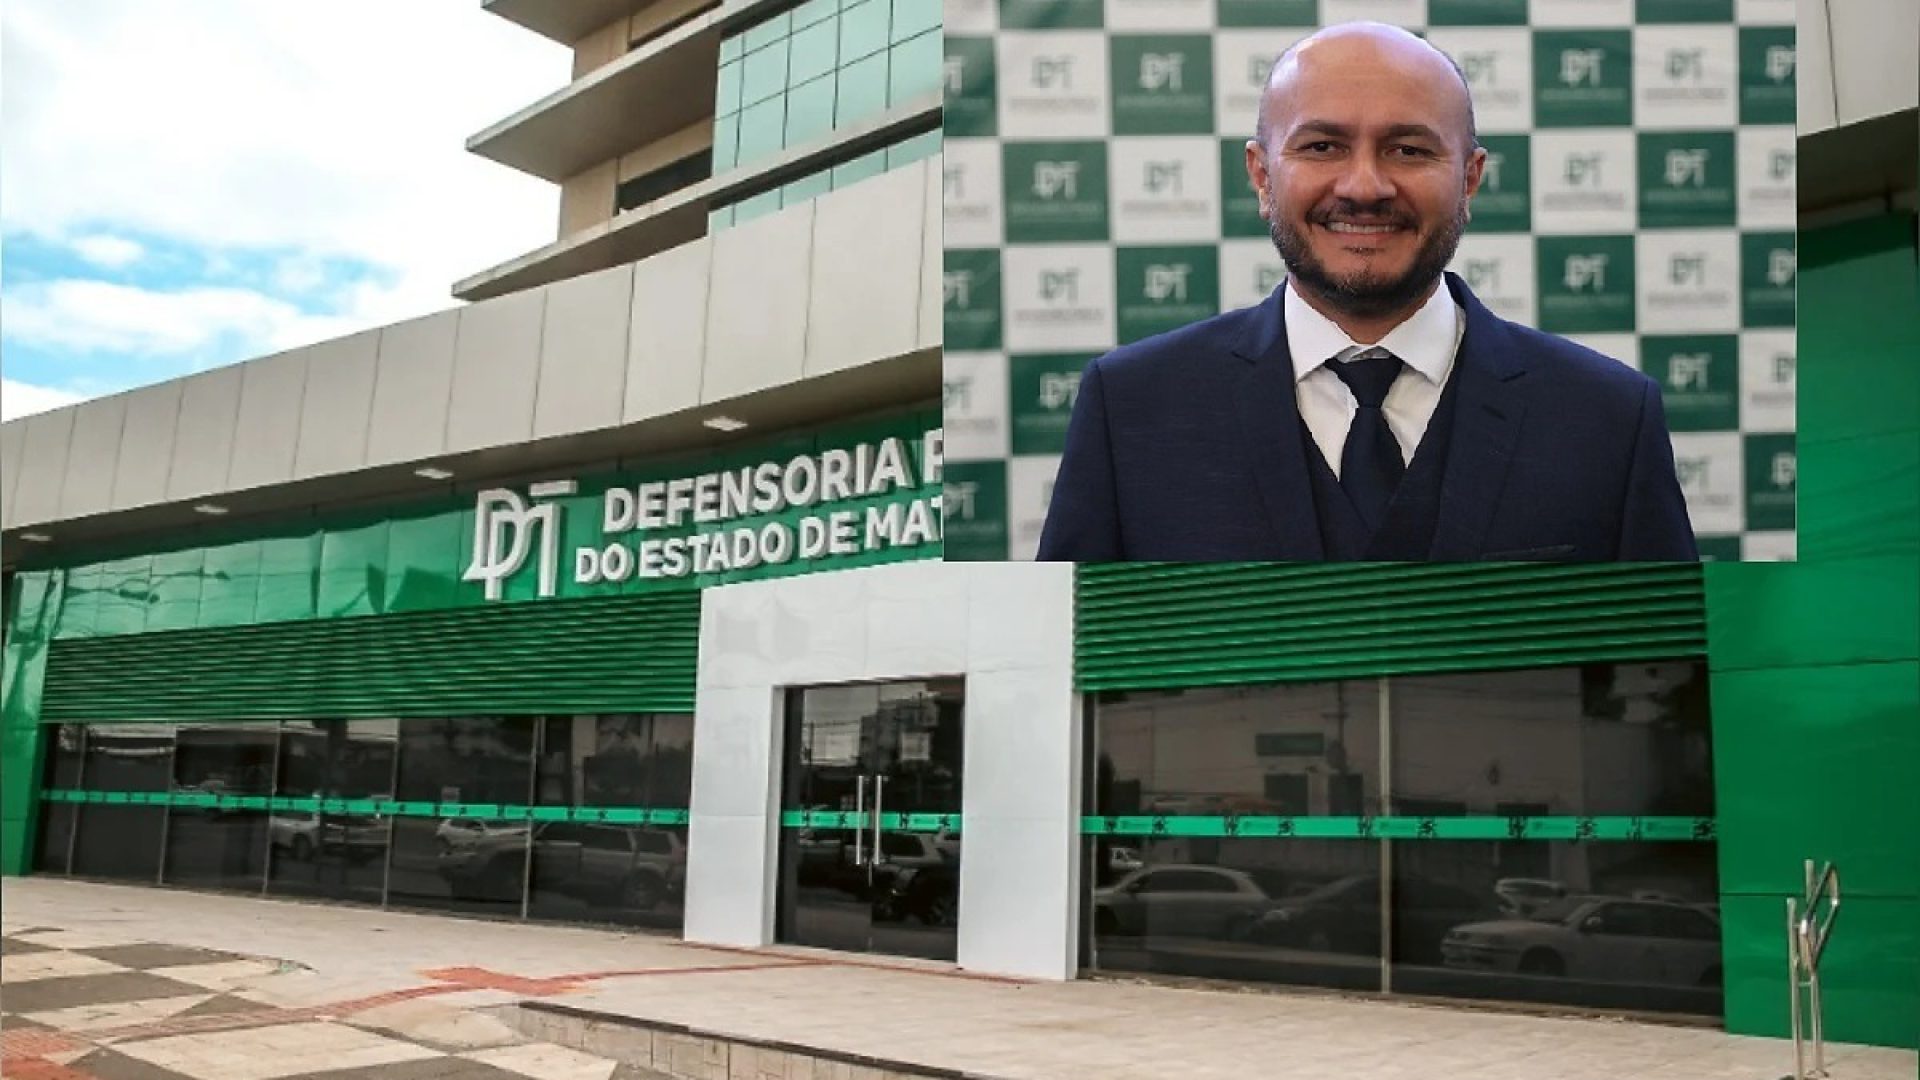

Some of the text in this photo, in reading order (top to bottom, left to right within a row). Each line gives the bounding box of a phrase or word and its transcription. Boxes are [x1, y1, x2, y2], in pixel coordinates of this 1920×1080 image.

[603, 436, 912, 533] DEFENSORIA
[575, 542, 634, 583] DO
[639, 521, 793, 578] ESTADO
[799, 511, 860, 559] DE
